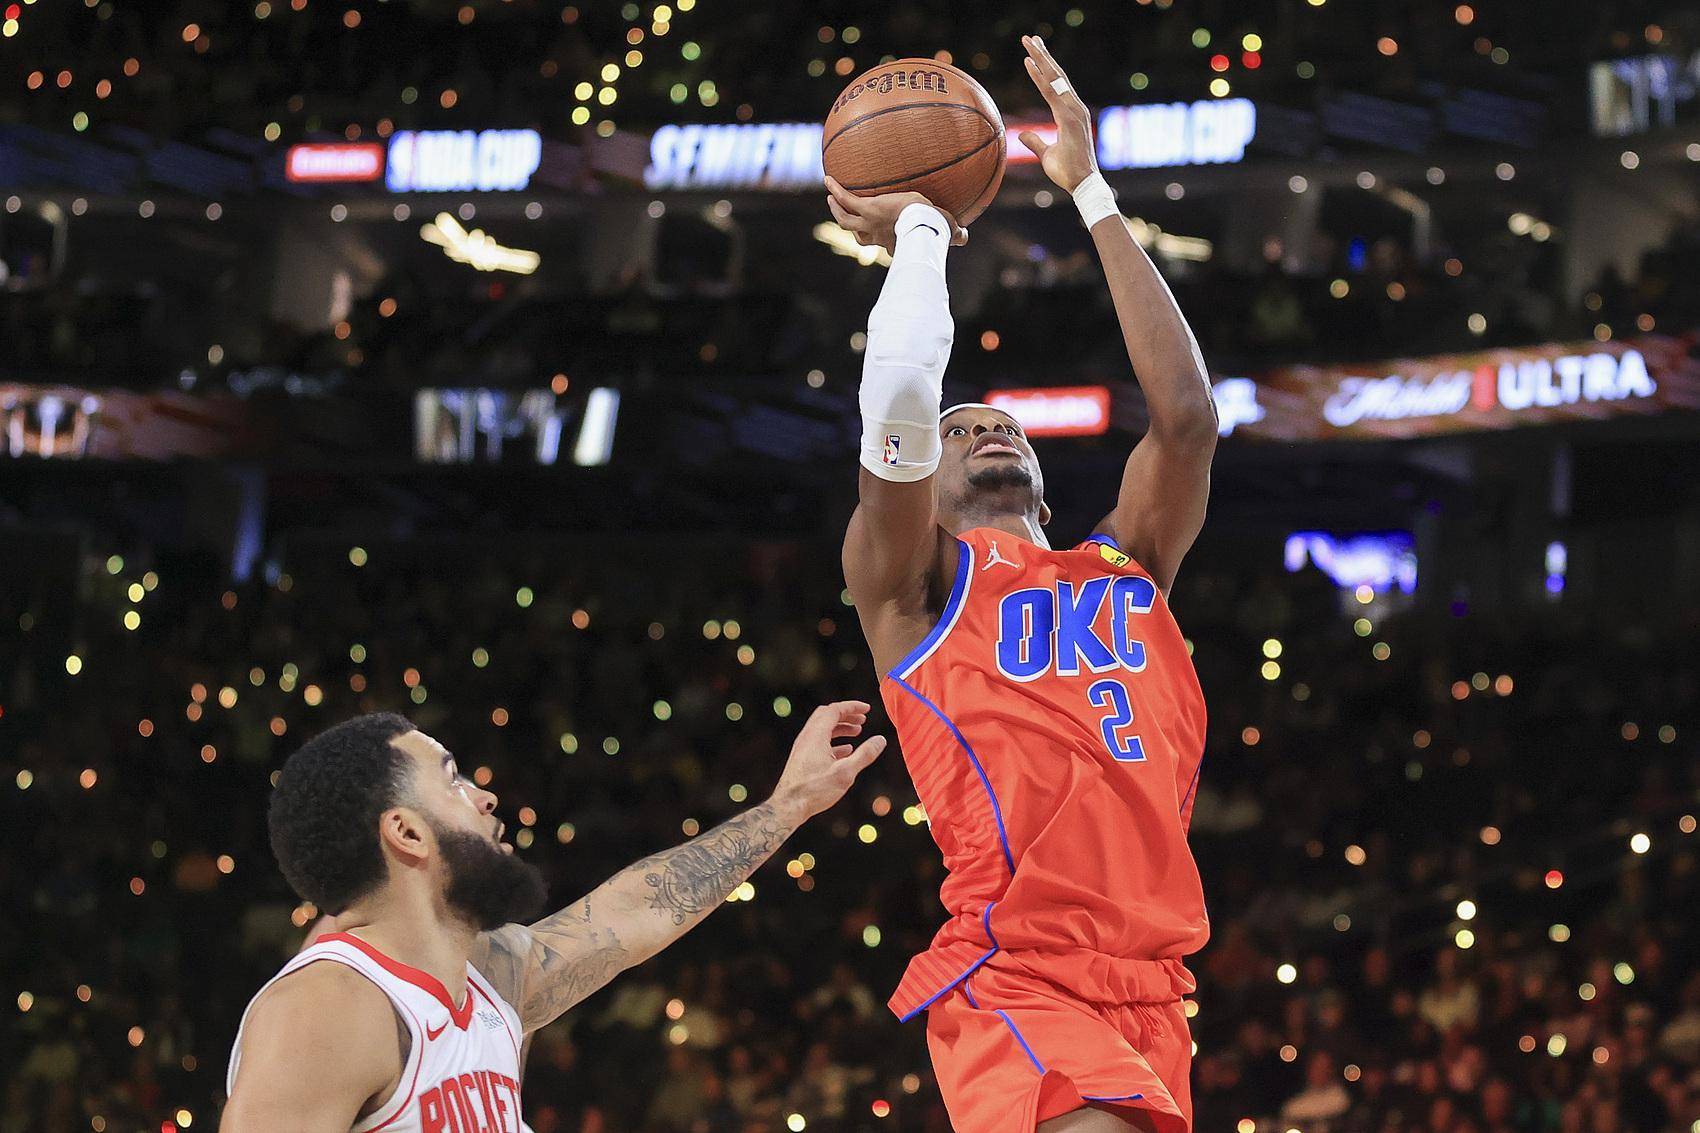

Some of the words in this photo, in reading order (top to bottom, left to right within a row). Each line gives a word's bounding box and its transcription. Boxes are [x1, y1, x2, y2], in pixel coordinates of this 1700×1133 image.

[833, 69, 950, 115] Wilson
[1497, 349, 1657, 411] ULTRA
[995, 575, 1157, 682] OKC
[1086, 678, 1148, 762] 2
[418, 1070, 521, 1133] ROCKET
